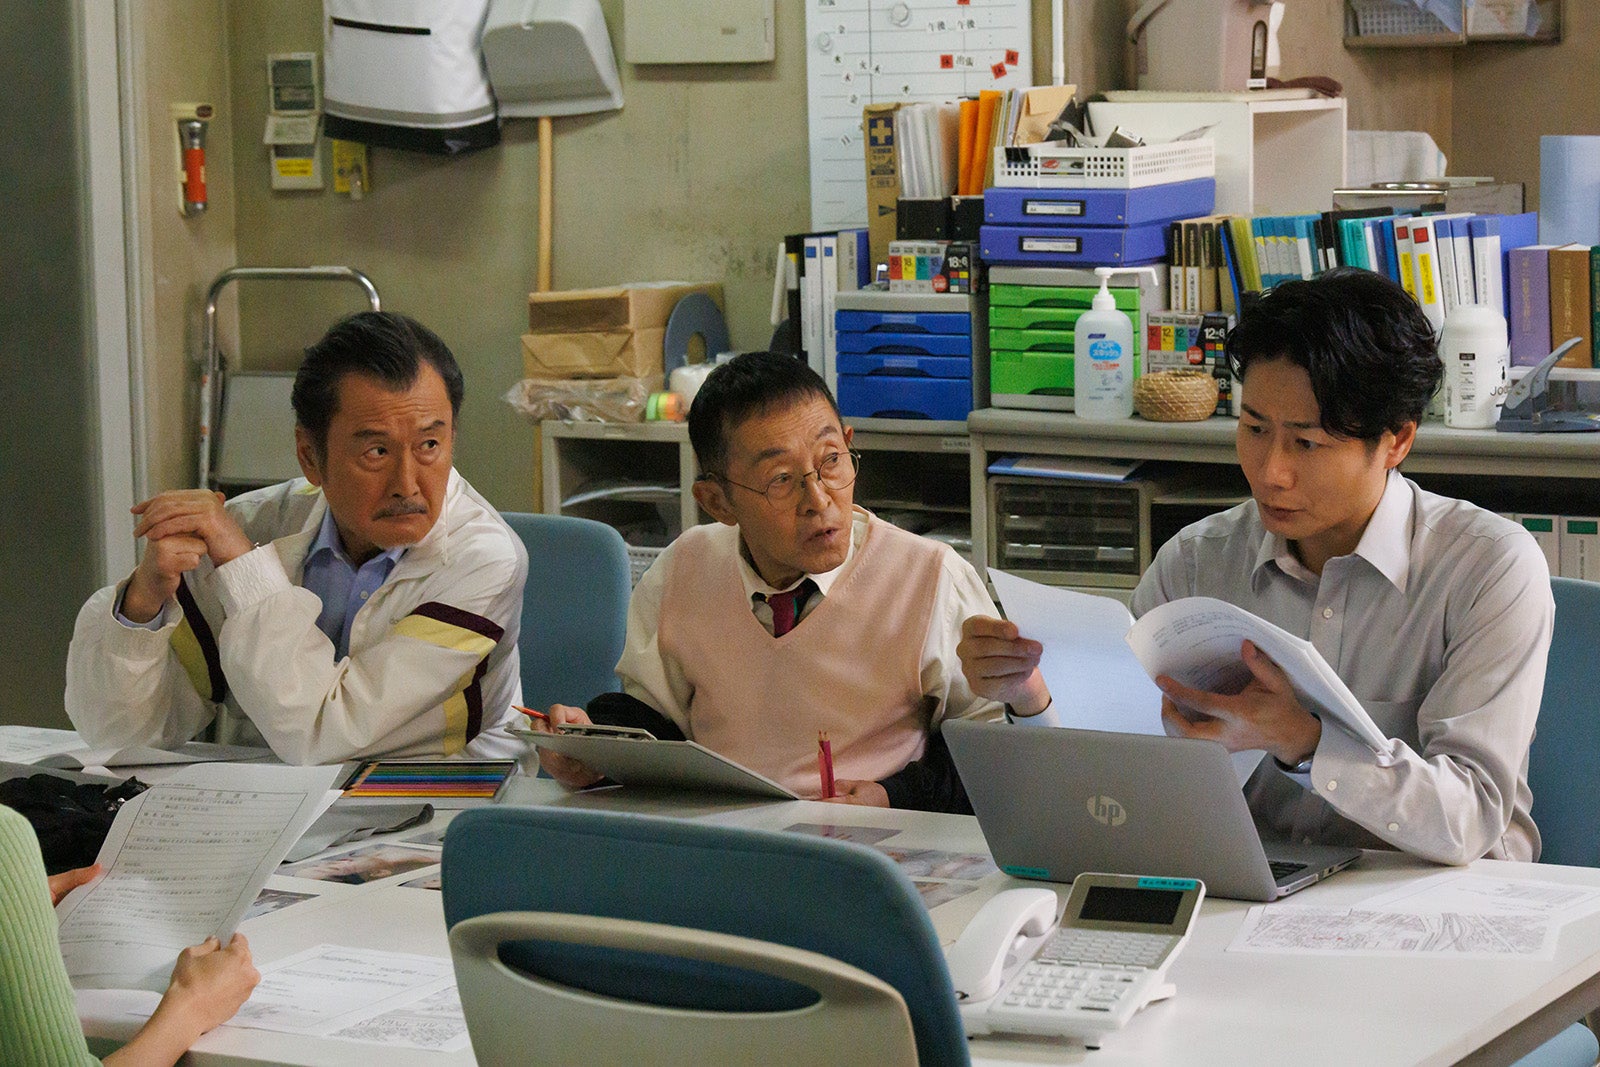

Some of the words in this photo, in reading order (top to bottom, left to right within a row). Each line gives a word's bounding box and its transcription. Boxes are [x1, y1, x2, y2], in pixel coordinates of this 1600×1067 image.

[1162, 328, 1171, 337] 12
[1175, 328, 1184, 337] 12
[1188, 328, 1197, 337] 12
